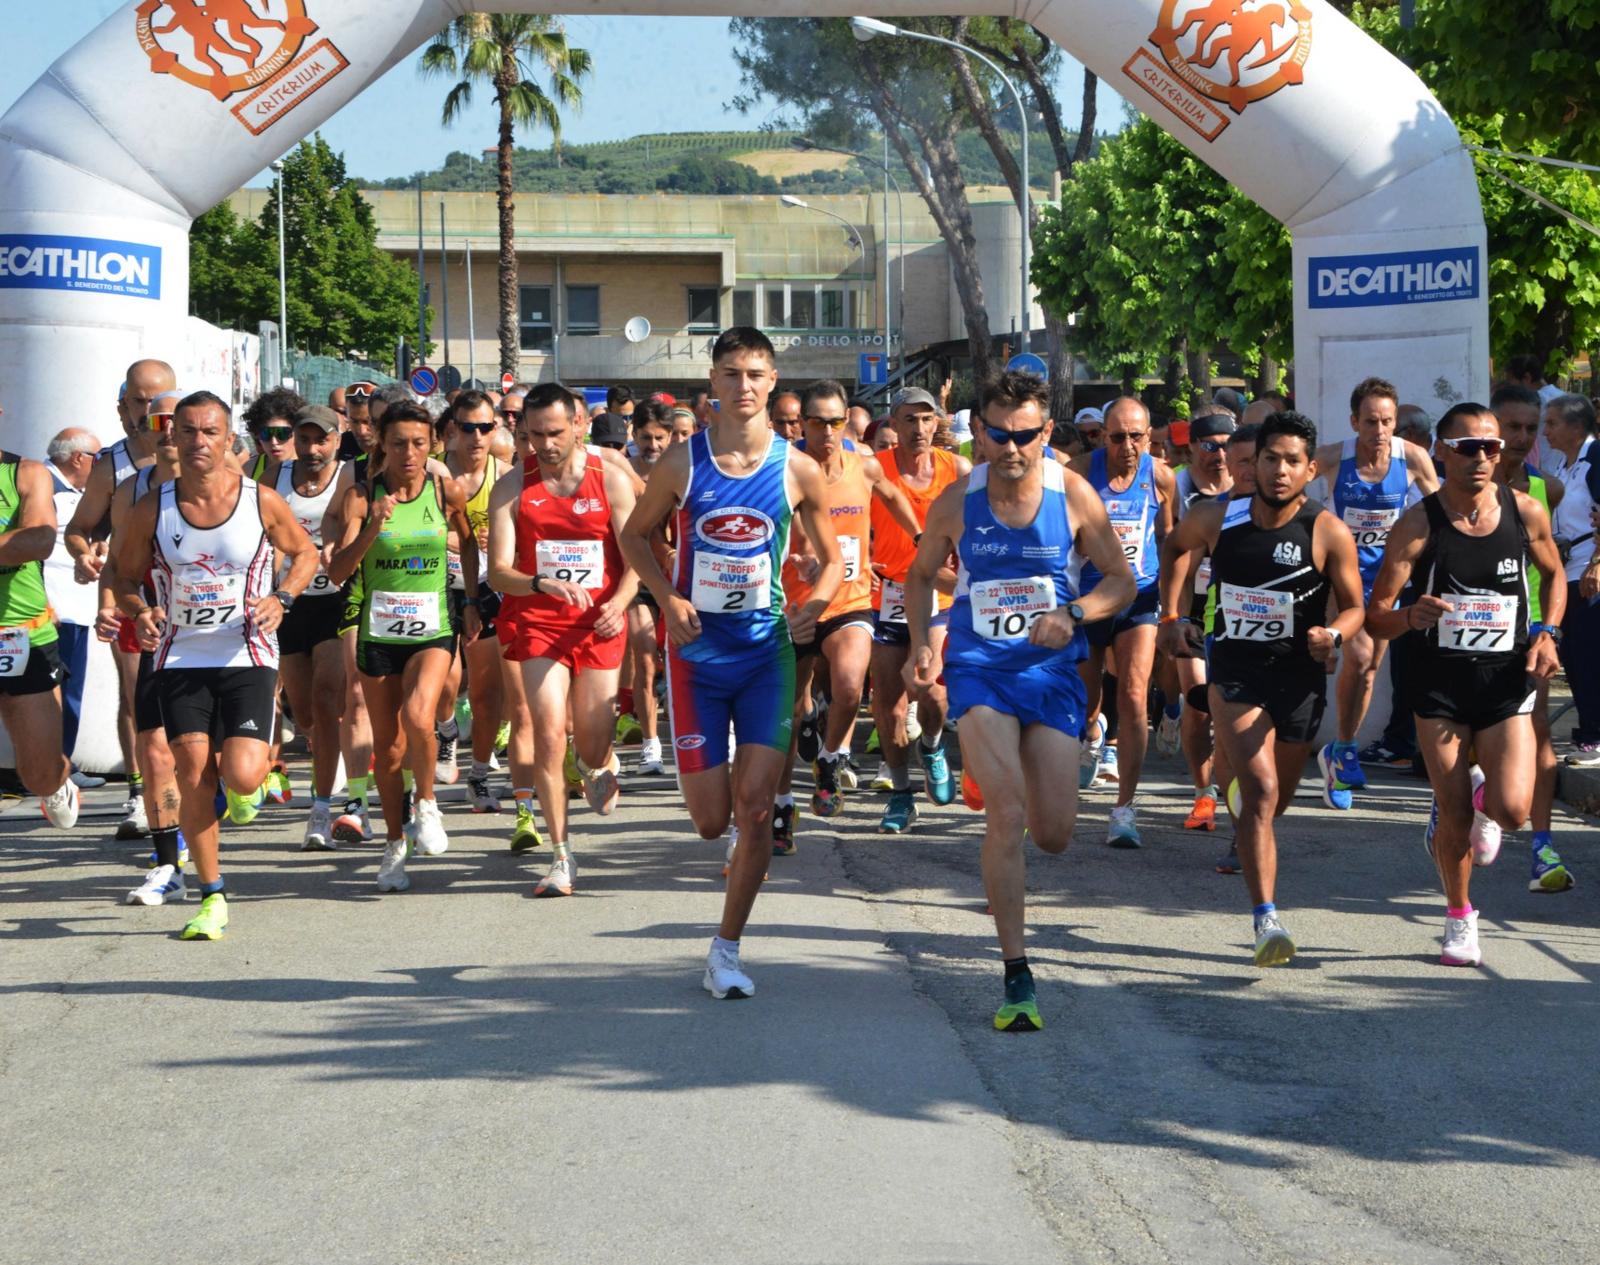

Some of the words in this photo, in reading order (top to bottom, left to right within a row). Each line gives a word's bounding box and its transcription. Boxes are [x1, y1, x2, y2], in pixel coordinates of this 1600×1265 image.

[244, 48, 291, 86] RUNNING
[1170, 56, 1213, 94] RUNNING
[256, 61, 325, 115] CRITERIUM
[1143, 68, 1206, 122] CRITERIUM
[1318, 259, 1472, 297] DECATHLON
[74, 281, 112, 290] BENEDETTO
[126, 286, 149, 295] TRONTO
[1414, 292, 1445, 300] BENEDETTO
[808, 335, 850, 346] DELLO
[1352, 531, 1389, 545] 104
[564, 546, 589, 554] TROFEO
[1273, 541, 1302, 562] ASA
[727, 563, 755, 574] TROFEO
[1497, 558, 1519, 575] ASA
[555, 568, 591, 584] 97
[719, 573, 749, 583] AVIS
[195, 584, 224, 593] TROFEO
[1004, 585, 1035, 595] TROFEO
[190, 593, 217, 601] AVIS
[399, 598, 424, 606] TROFEO
[722, 590, 746, 610] 2
[998, 595, 1028, 606] AVIS
[1248, 595, 1275, 606] TROFEO
[393, 606, 417, 614] AVIS
[1241, 603, 1268, 614] AVIS
[1473, 603, 1501, 611] TROFEO
[183, 605, 236, 625] 127
[1465, 612, 1492, 620] AVIS
[387, 620, 426, 636] 42
[1231, 618, 1284, 638] 179
[1452, 628, 1508, 648] 177
